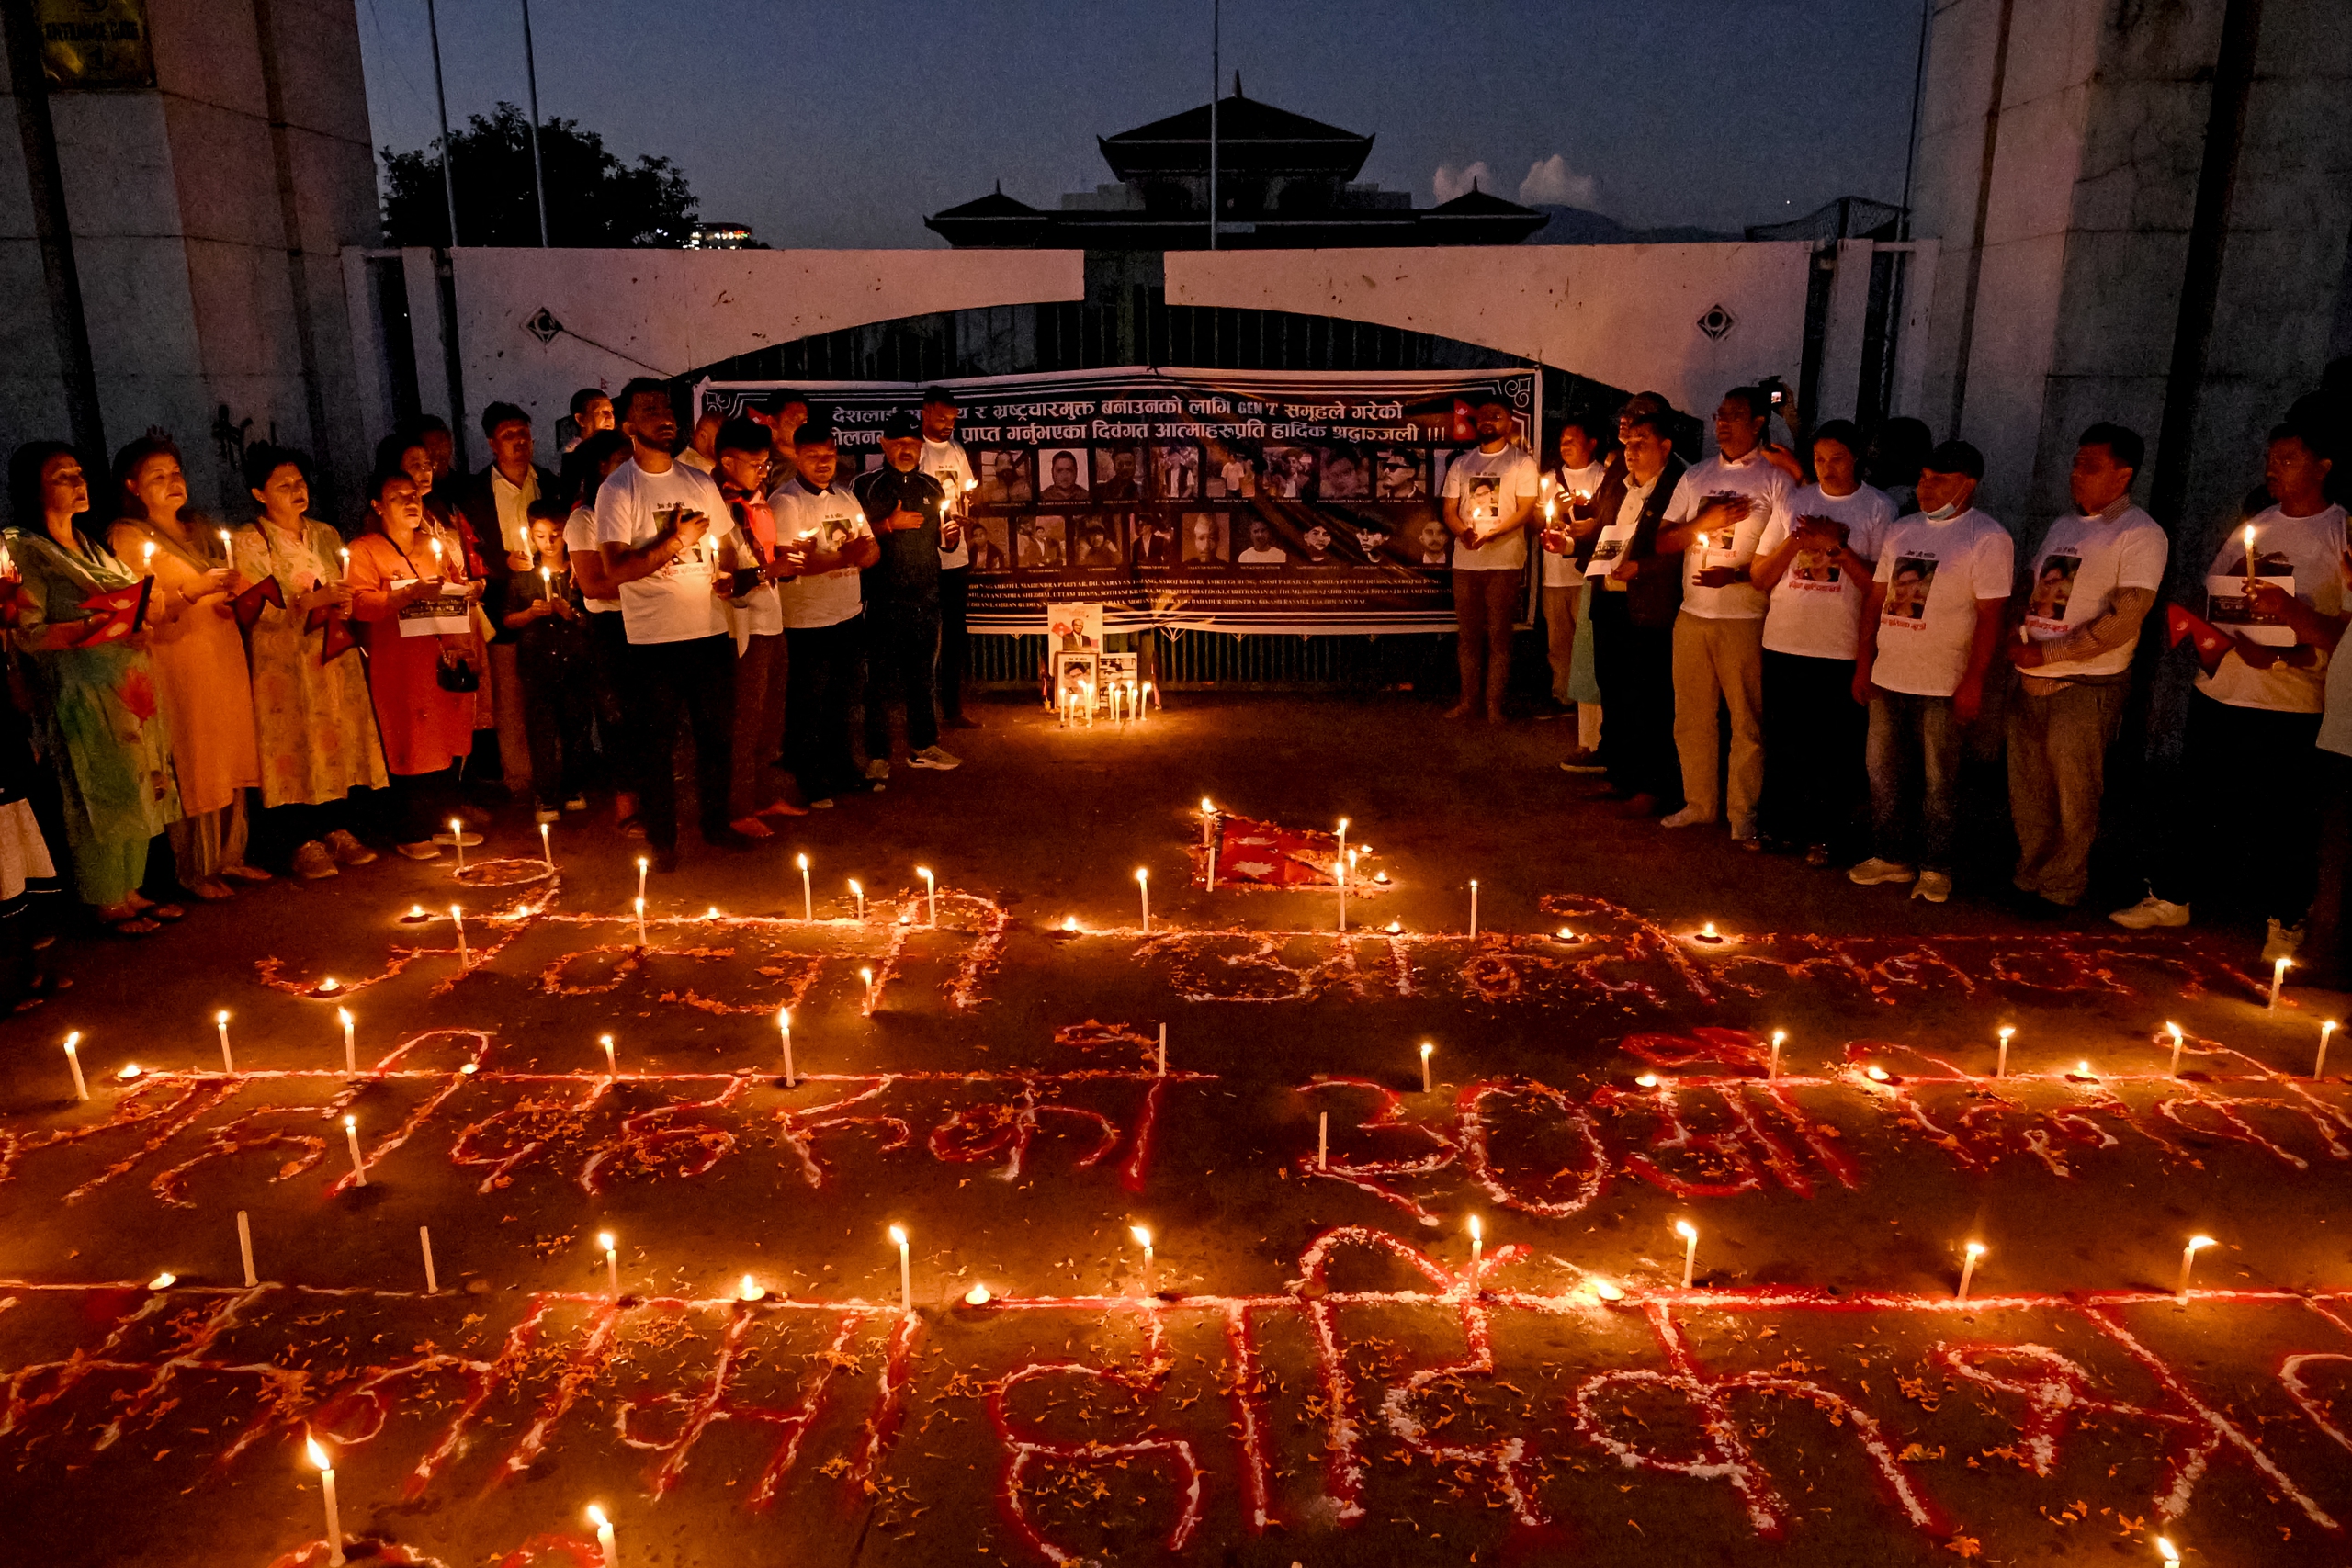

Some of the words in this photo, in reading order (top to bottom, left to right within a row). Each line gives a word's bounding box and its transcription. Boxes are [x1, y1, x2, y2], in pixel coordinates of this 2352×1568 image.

[975, 406, 988, 419] र
[1102, 395, 1183, 415] बनाउनको
[1188, 396, 1231, 415] लागि
[1238, 401, 1262, 415] GEN
[1283, 400, 1347, 423] समूहले
[1351, 400, 1404, 421] गरेको
[960, 426, 1001, 444] प्राप्त
[1006, 422, 1088, 446] गर्नुभएका
[1271, 421, 1327, 440] हार्दिक
